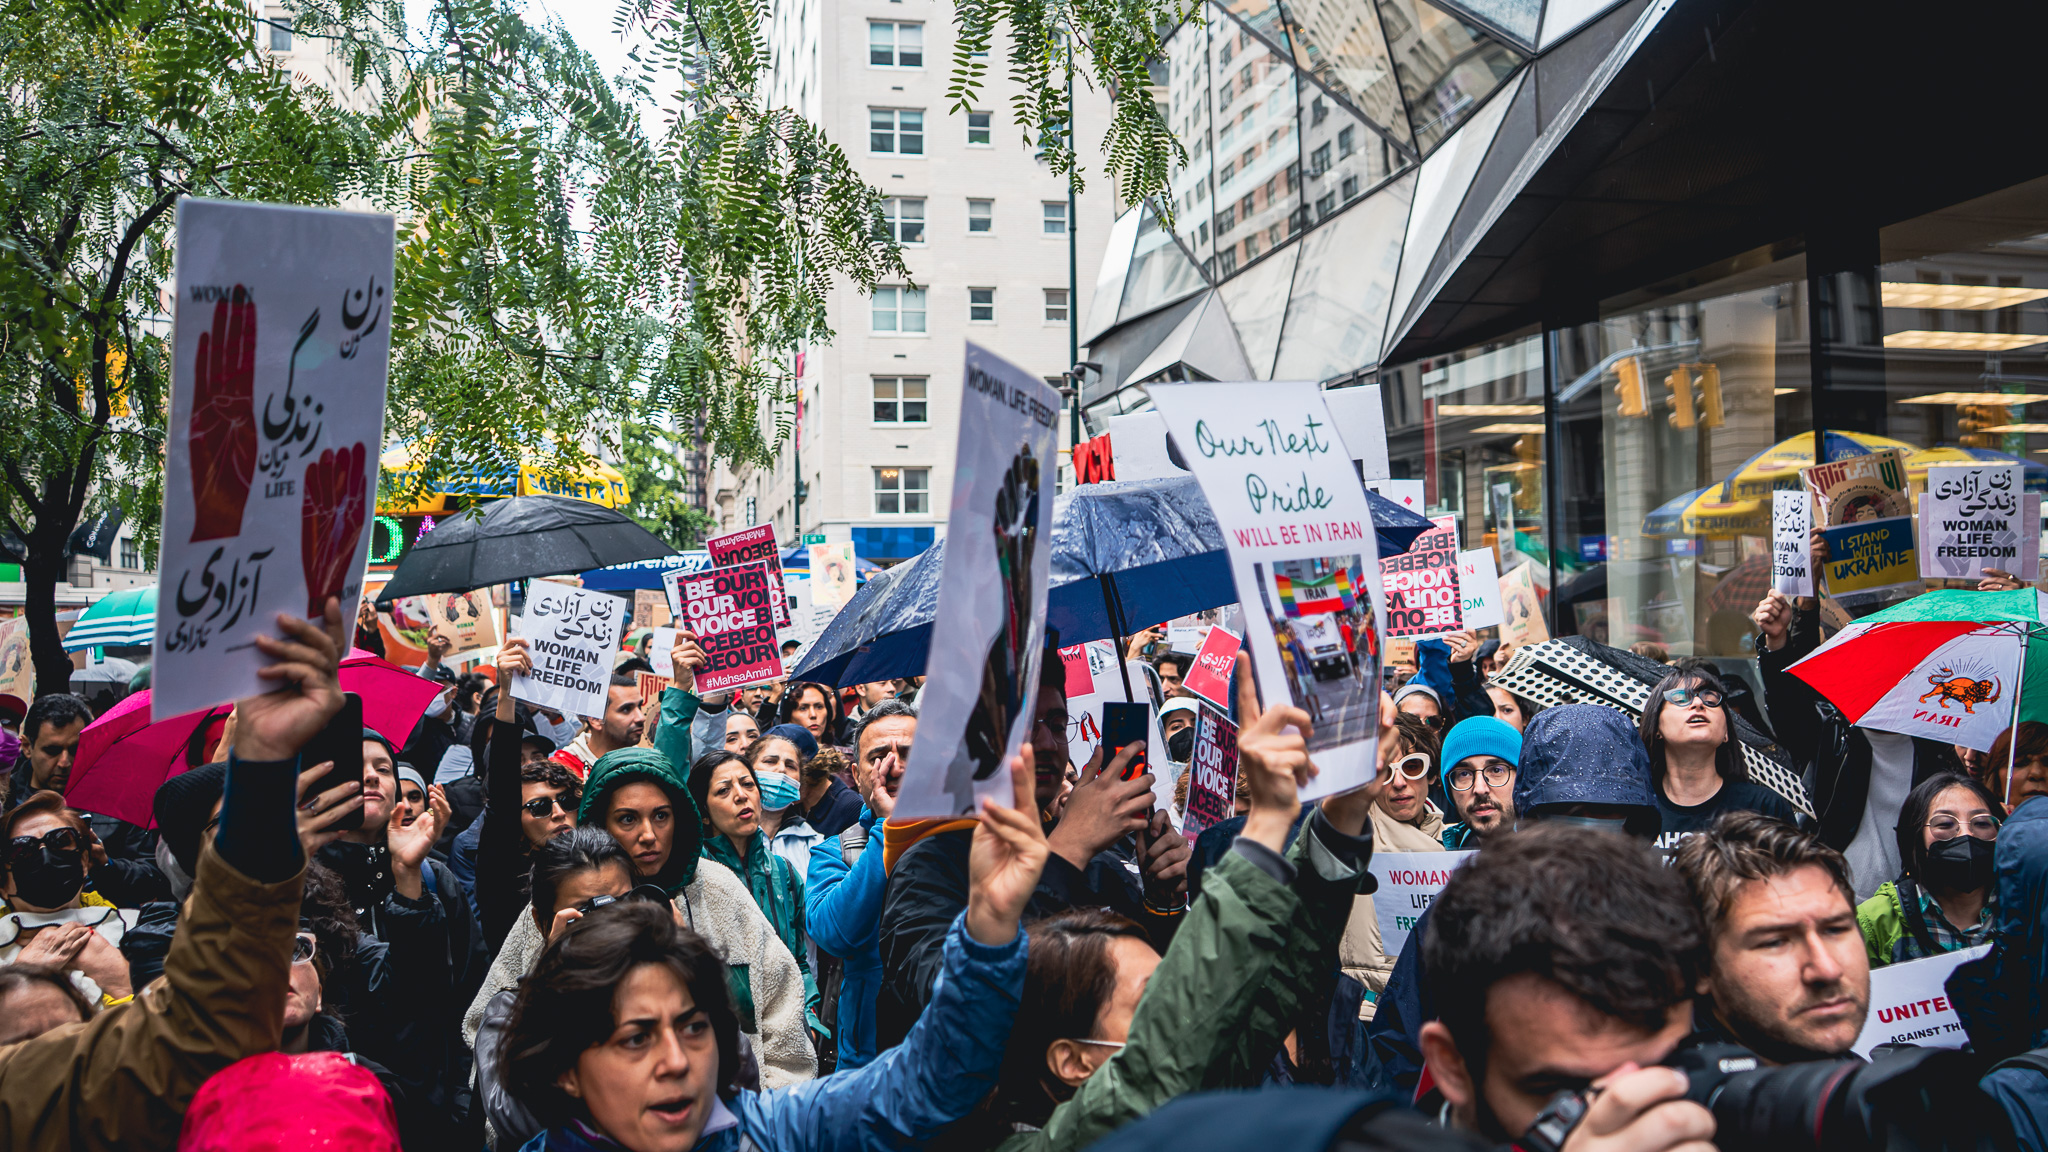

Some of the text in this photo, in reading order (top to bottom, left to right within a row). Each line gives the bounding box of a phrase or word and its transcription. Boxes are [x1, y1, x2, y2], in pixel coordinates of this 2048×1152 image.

[342, 275, 384, 337] زن
[263, 307, 324, 456] زندگی
[1195, 414, 1329, 460] Our Next
[264, 479, 296, 499] LIFE
[1246, 471, 1333, 514] Pride
[1935, 469, 2012, 501] زن آزادی
[1959, 488, 2017, 517] زندگی
[1233, 521, 1363, 548] WILL BE IN IRAN
[1942, 520, 2008, 531] WOMAN
[1840, 528, 1890, 550] I STAND
[1852, 542, 1882, 559] WITH
[1957, 533, 1993, 544] LIFE
[1937, 546, 2016, 557] FREEDOM
[1834, 551, 1909, 580] UKRAINE
[176, 545, 276, 633] آزادی
[1303, 587, 1328, 600] IRAN
[533, 592, 586, 623] آزادی
[590, 599, 613, 621] زن
[554, 614, 612, 649] زندگی
[534, 639, 599, 664] WOMAN
[1200, 653, 1234, 672] آزادی
[545, 656, 582, 675] LIFE
[706, 665, 773, 689] #MahsaAmini
[530, 668, 602, 695] REEDOM
[1389, 870, 1453, 886] WOMAN
[1877, 996, 1954, 1024] UNITE
[1891, 1022, 1963, 1044] AGAINST TH
